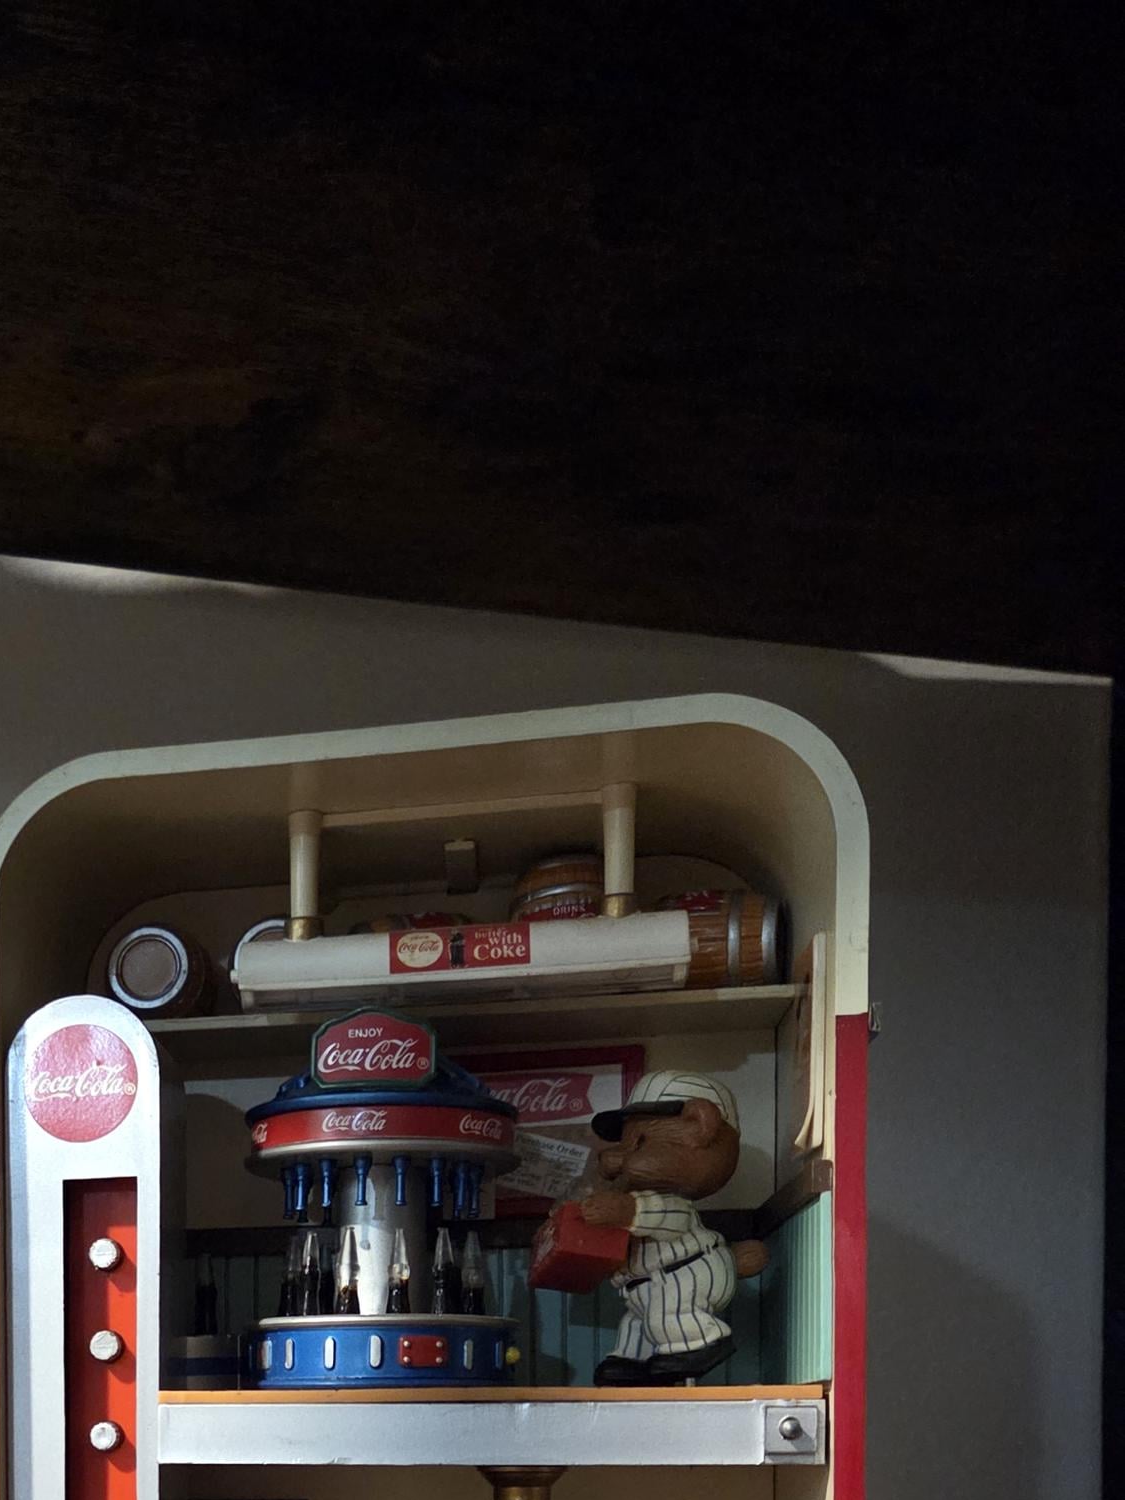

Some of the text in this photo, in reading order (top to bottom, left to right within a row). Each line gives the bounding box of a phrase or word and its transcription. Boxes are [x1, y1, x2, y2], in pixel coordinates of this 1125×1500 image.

[488, 931, 523, 946] with
[473, 943, 527, 961] Coke
[347, 1026, 384, 1039] ENJOY
[317, 1038, 420, 1073] Coca-Cola
[322, 1109, 389, 1134] Coca-Cola
